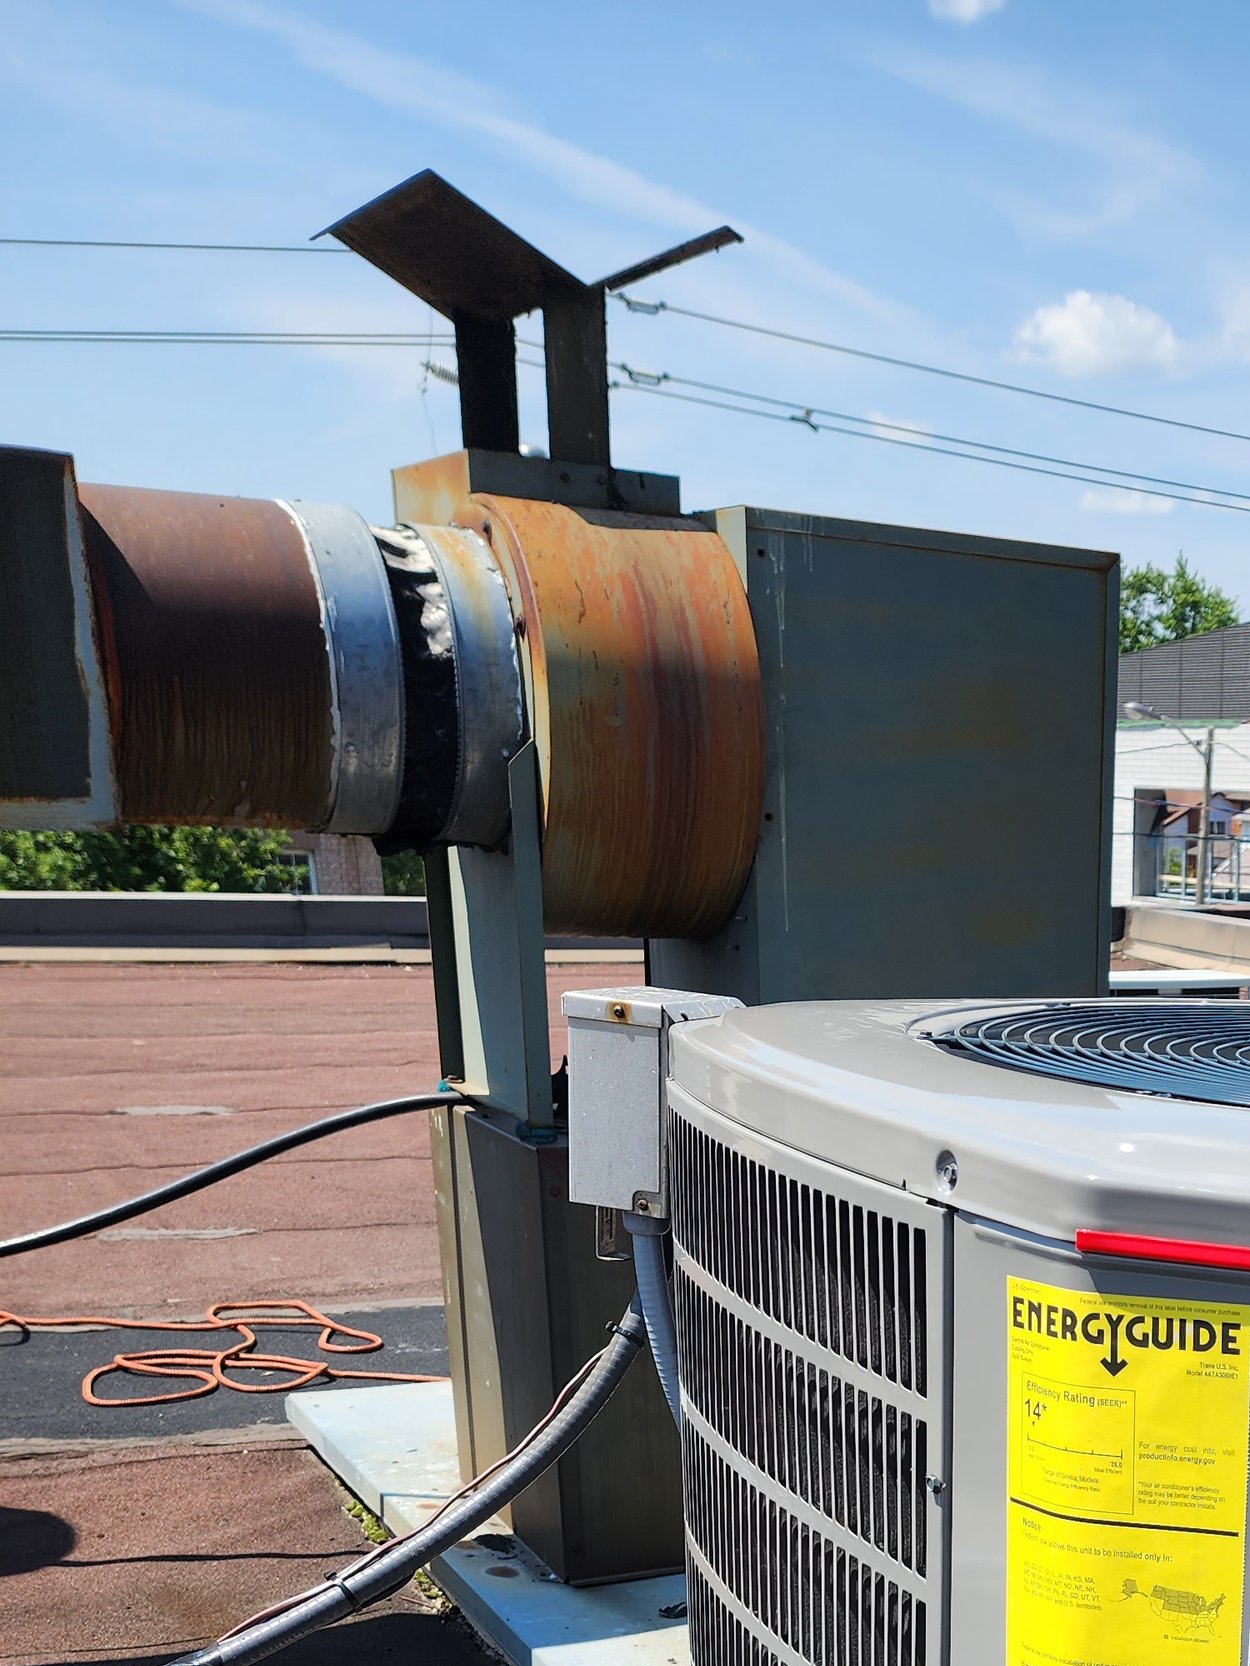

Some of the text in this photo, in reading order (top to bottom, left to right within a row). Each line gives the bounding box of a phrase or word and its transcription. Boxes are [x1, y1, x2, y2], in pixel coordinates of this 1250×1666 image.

[1012, 1296, 1241, 1355] ENERGYGUIDE
[1027, 1380, 1060, 1400] Efficiency
[1064, 1391, 1095, 1407] Rating
[1139, 1441, 1150, 1450] For
[1156, 1444, 1180, 1453] energy
[1139, 1453, 1215, 1466] productinfo.energy.gov
[1138, 1490, 1153, 1498] rating
[1154, 1492, 1166, 1500] may
[1191, 1494, 1218, 1503] depending
[1080, 1546, 1092, 1555] unit
[1094, 1548, 1102, 1556] to
[1102, 1548, 1112, 1557] be
[1113, 1550, 1143, 1560] installed
[1144, 1553, 1161, 1563] only
[1163, 1554, 1172, 1563] in:
